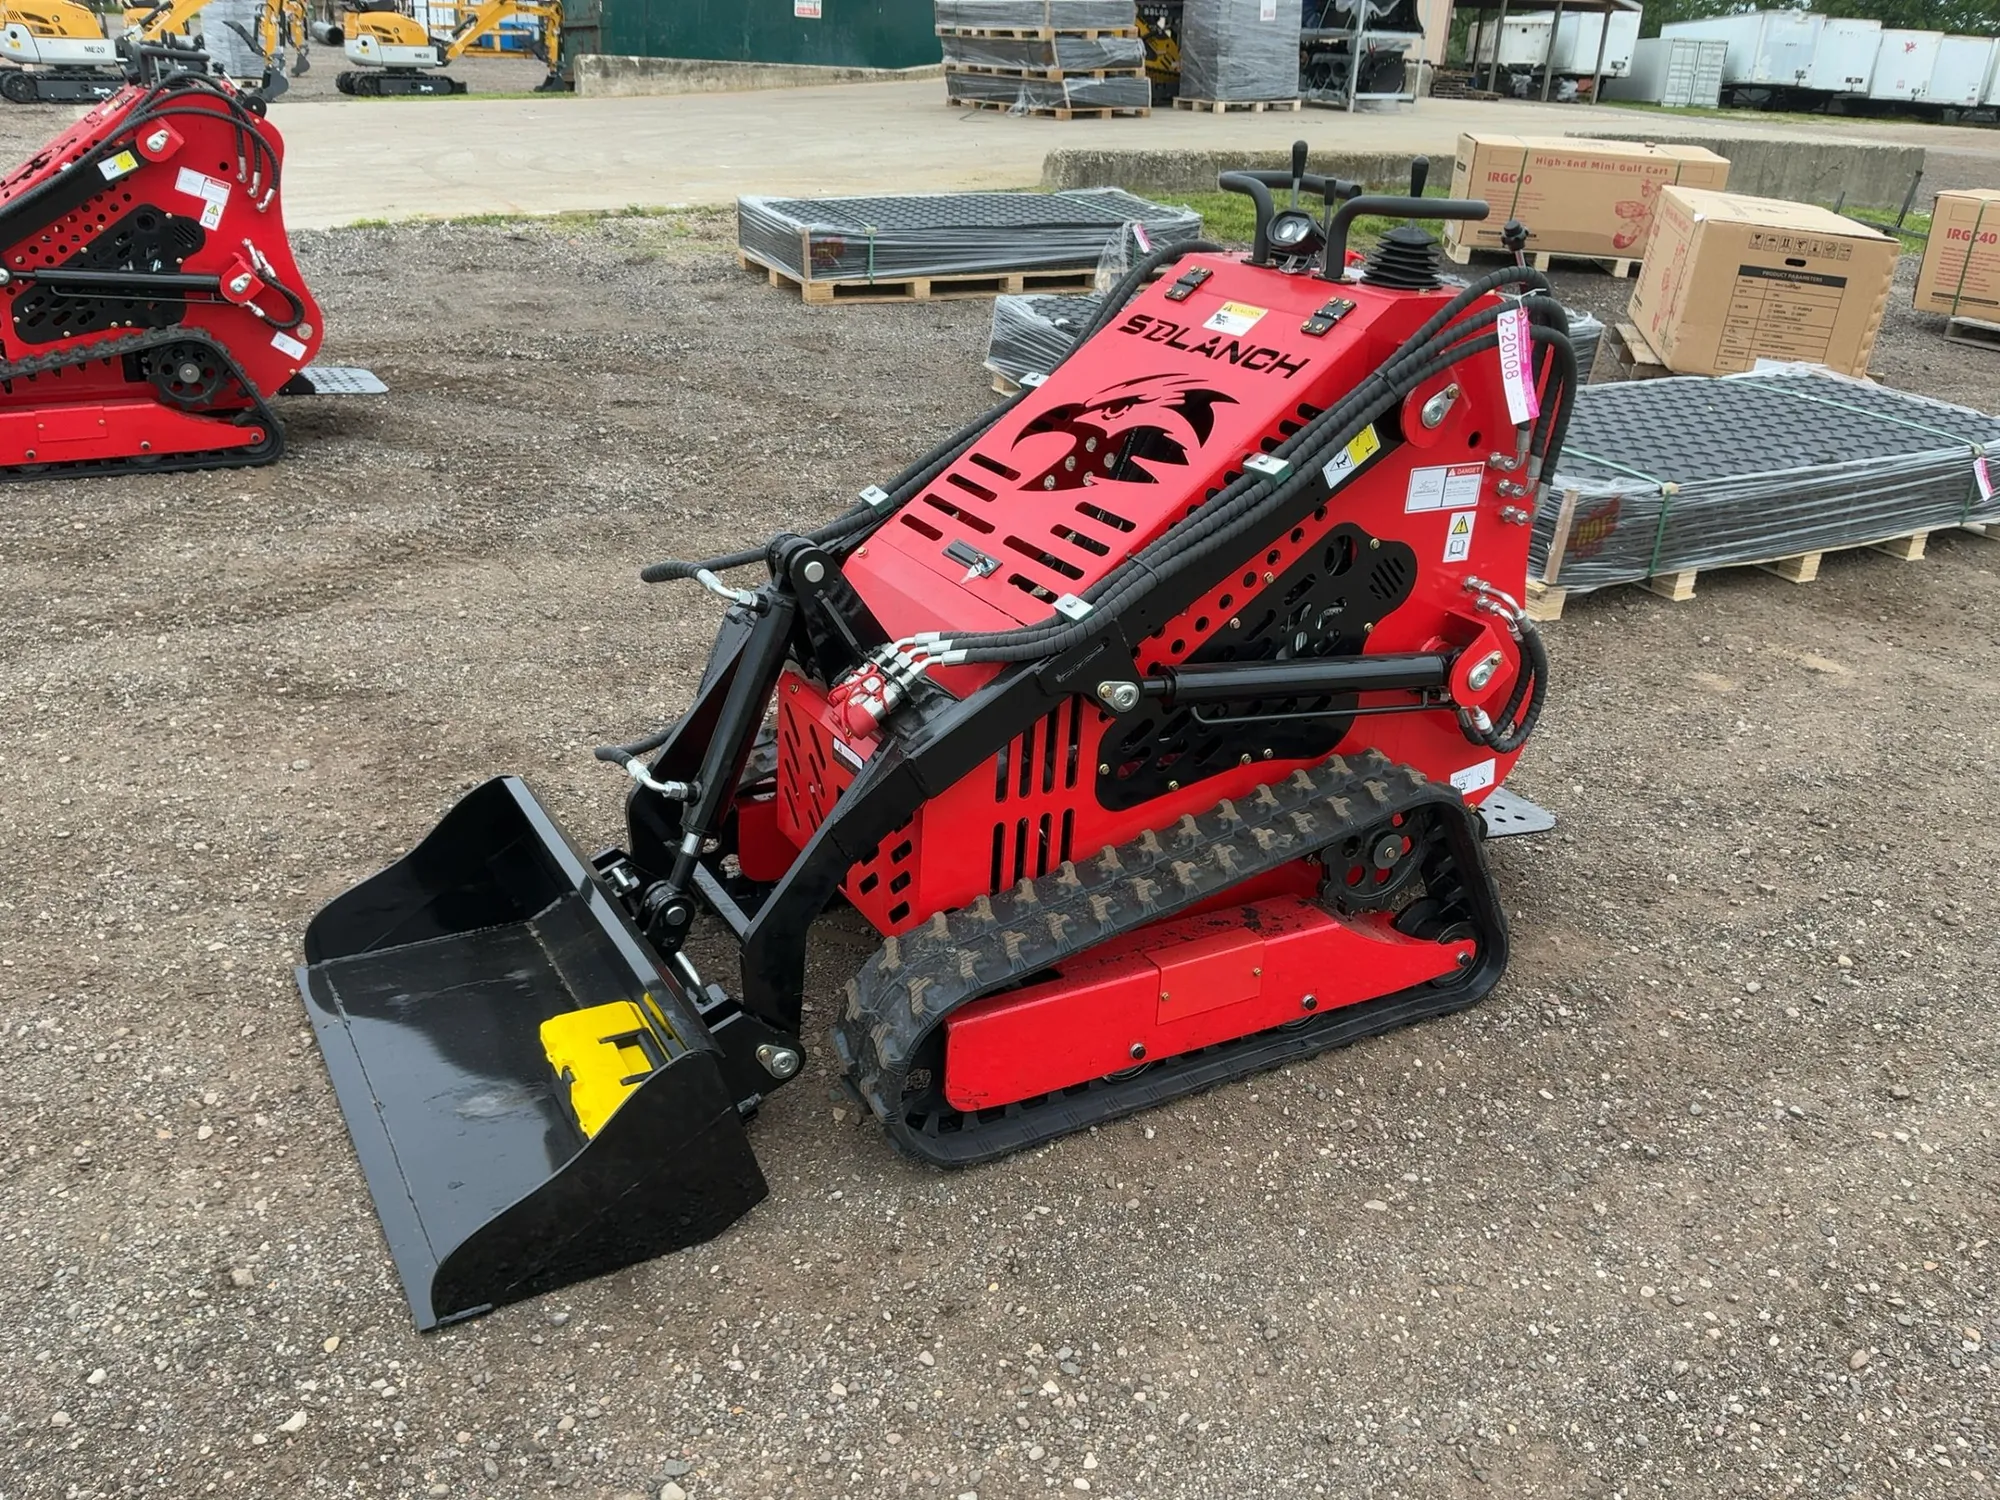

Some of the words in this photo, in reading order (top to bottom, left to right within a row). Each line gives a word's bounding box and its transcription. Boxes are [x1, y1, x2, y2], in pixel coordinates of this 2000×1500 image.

[84, 45, 105, 54] ME20
[1535, 156, 1587, 168] High-End
[1591, 161, 1616, 171] Mini
[1619, 164, 1642, 174] Golf
[1646, 166, 1669, 176] Cart
[1487, 171, 1532, 185] IRGC0
[1762, 270, 1787, 279] PRODUCT
[1117, 314, 1311, 380] SDLANCH
[1500, 316, 1519, 380] 2-20108
